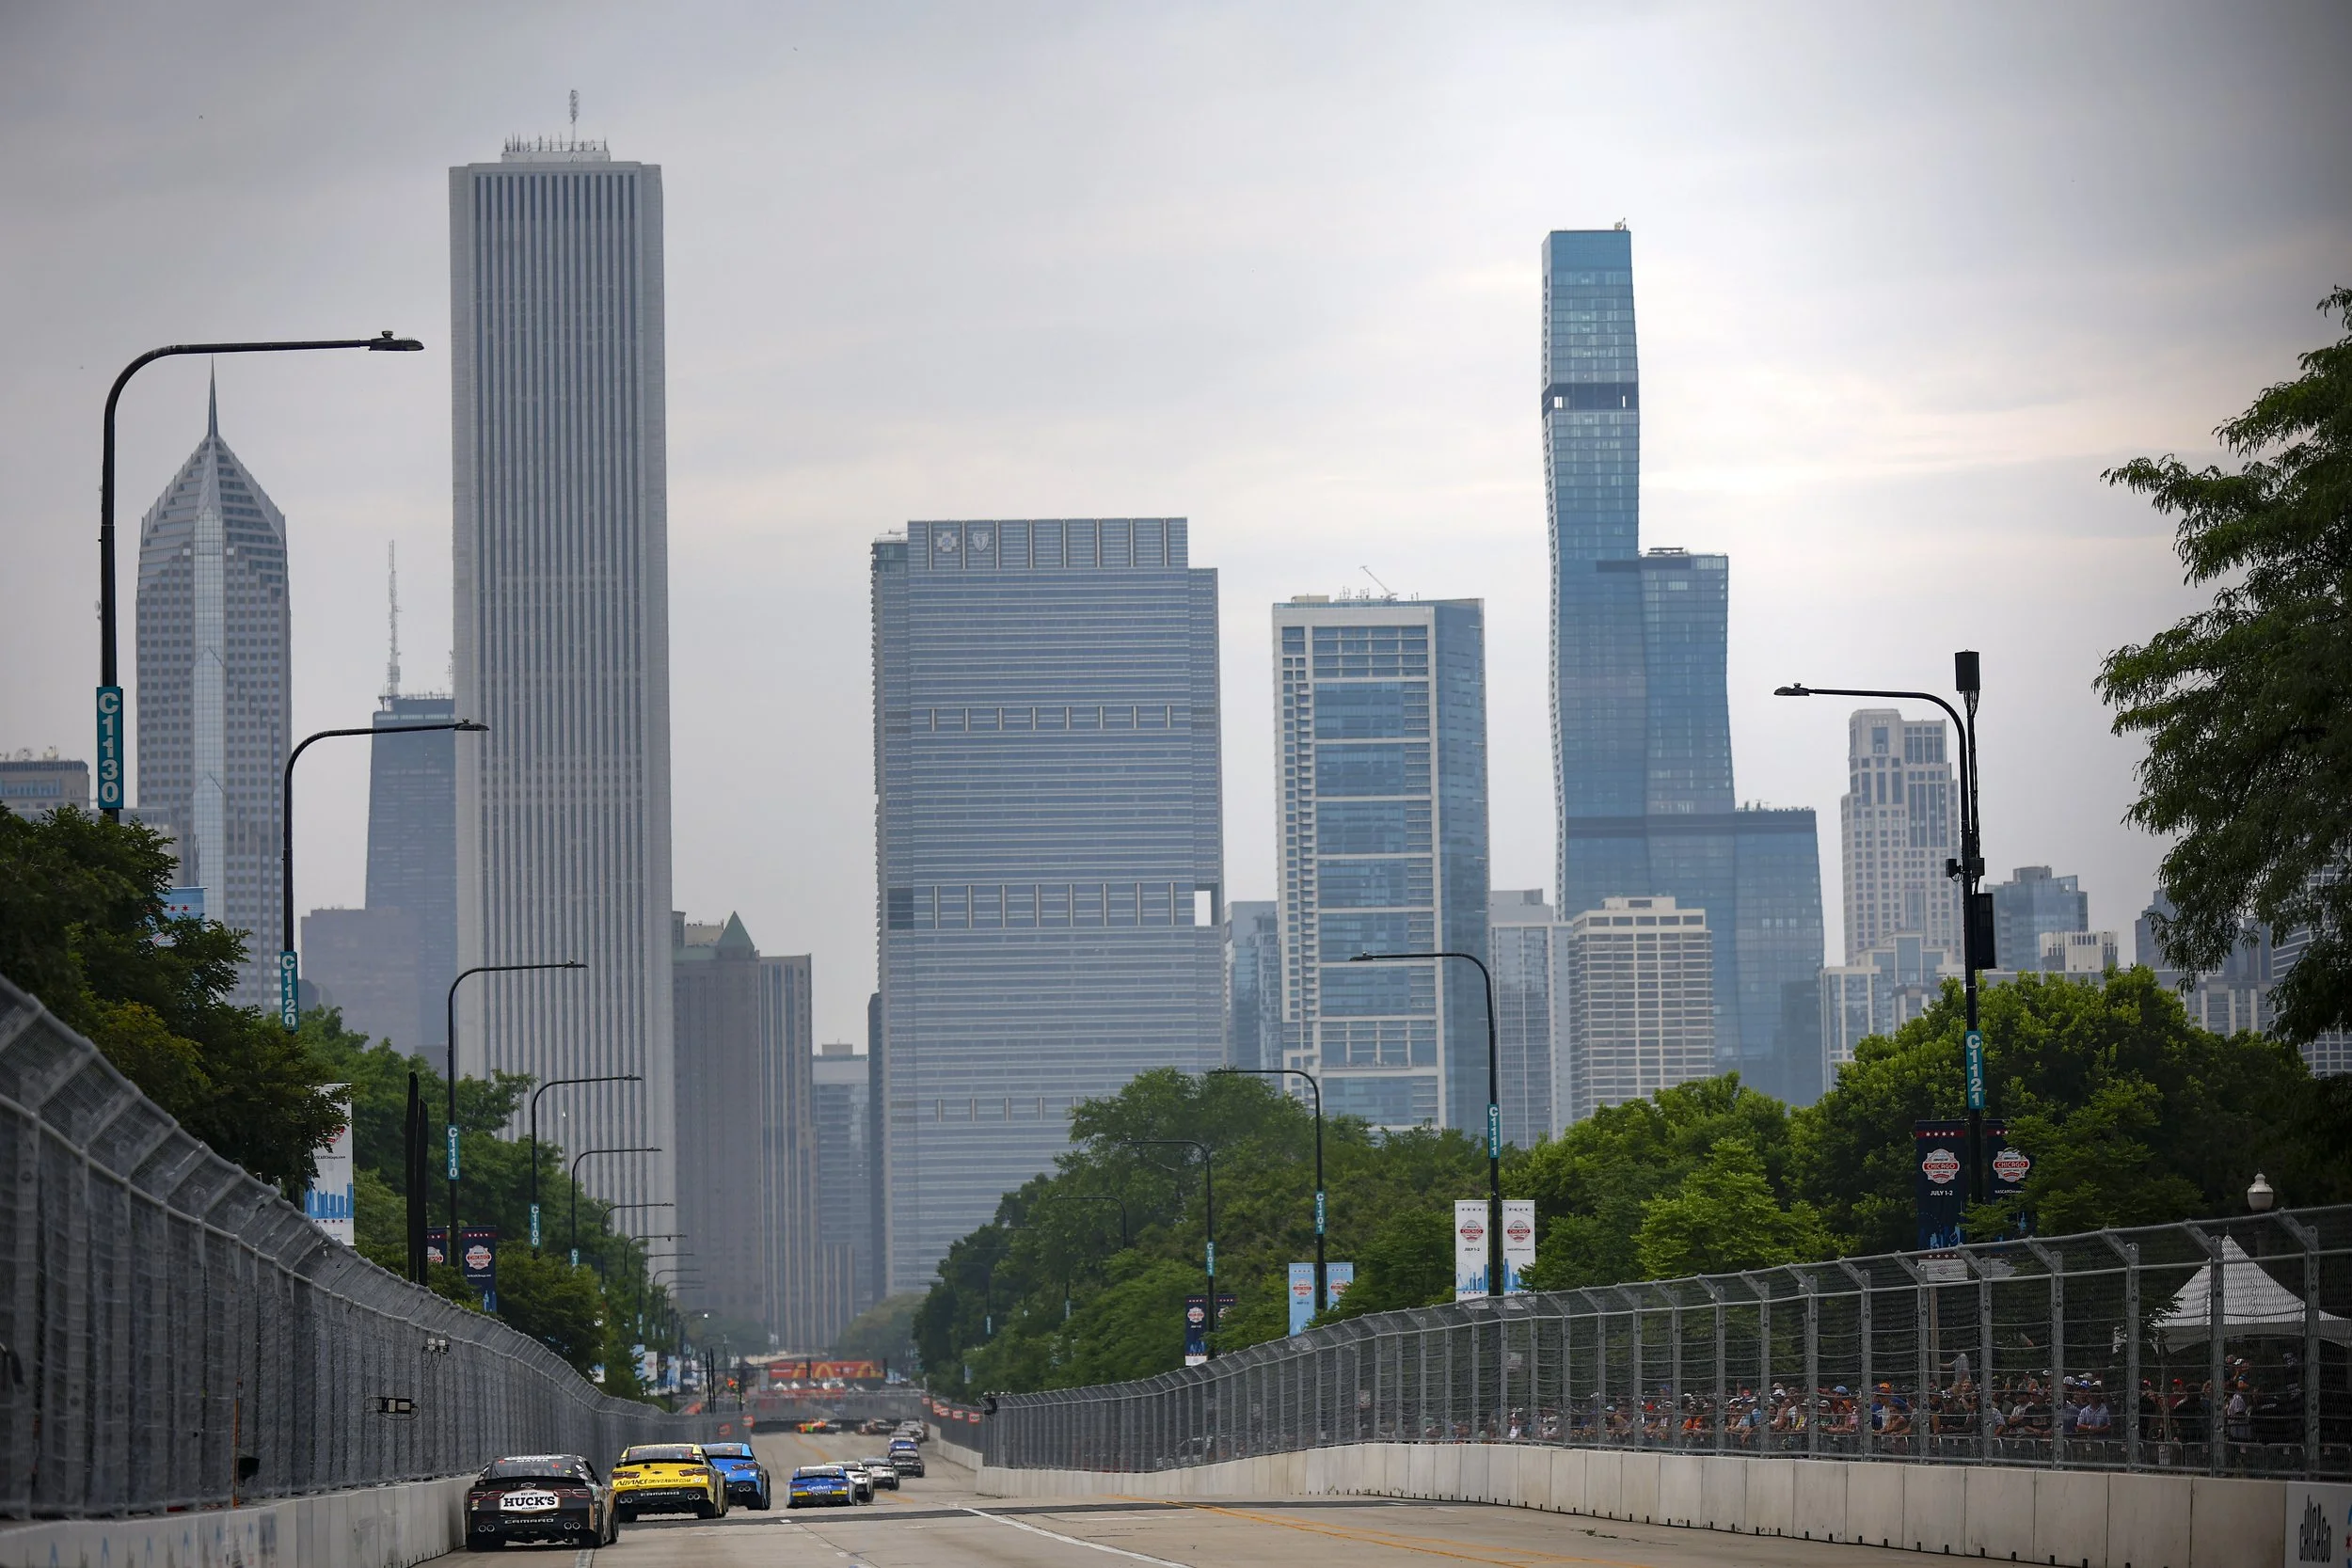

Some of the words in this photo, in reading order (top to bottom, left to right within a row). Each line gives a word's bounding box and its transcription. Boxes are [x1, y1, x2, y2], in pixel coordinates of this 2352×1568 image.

[98, 692, 119, 803] C1130
[281, 955, 296, 1027] C1120
[1967, 1035, 1982, 1106] C1121
[448, 1127, 458, 1178] C1110
[1489, 1106, 1499, 1156] C1111
[531, 1205, 539, 1246] C1100
[1316, 1193, 1325, 1232] C1101
[503, 1497, 555, 1507] HUCK'S
[2298, 1493, 2331, 1563] CHICAGO
